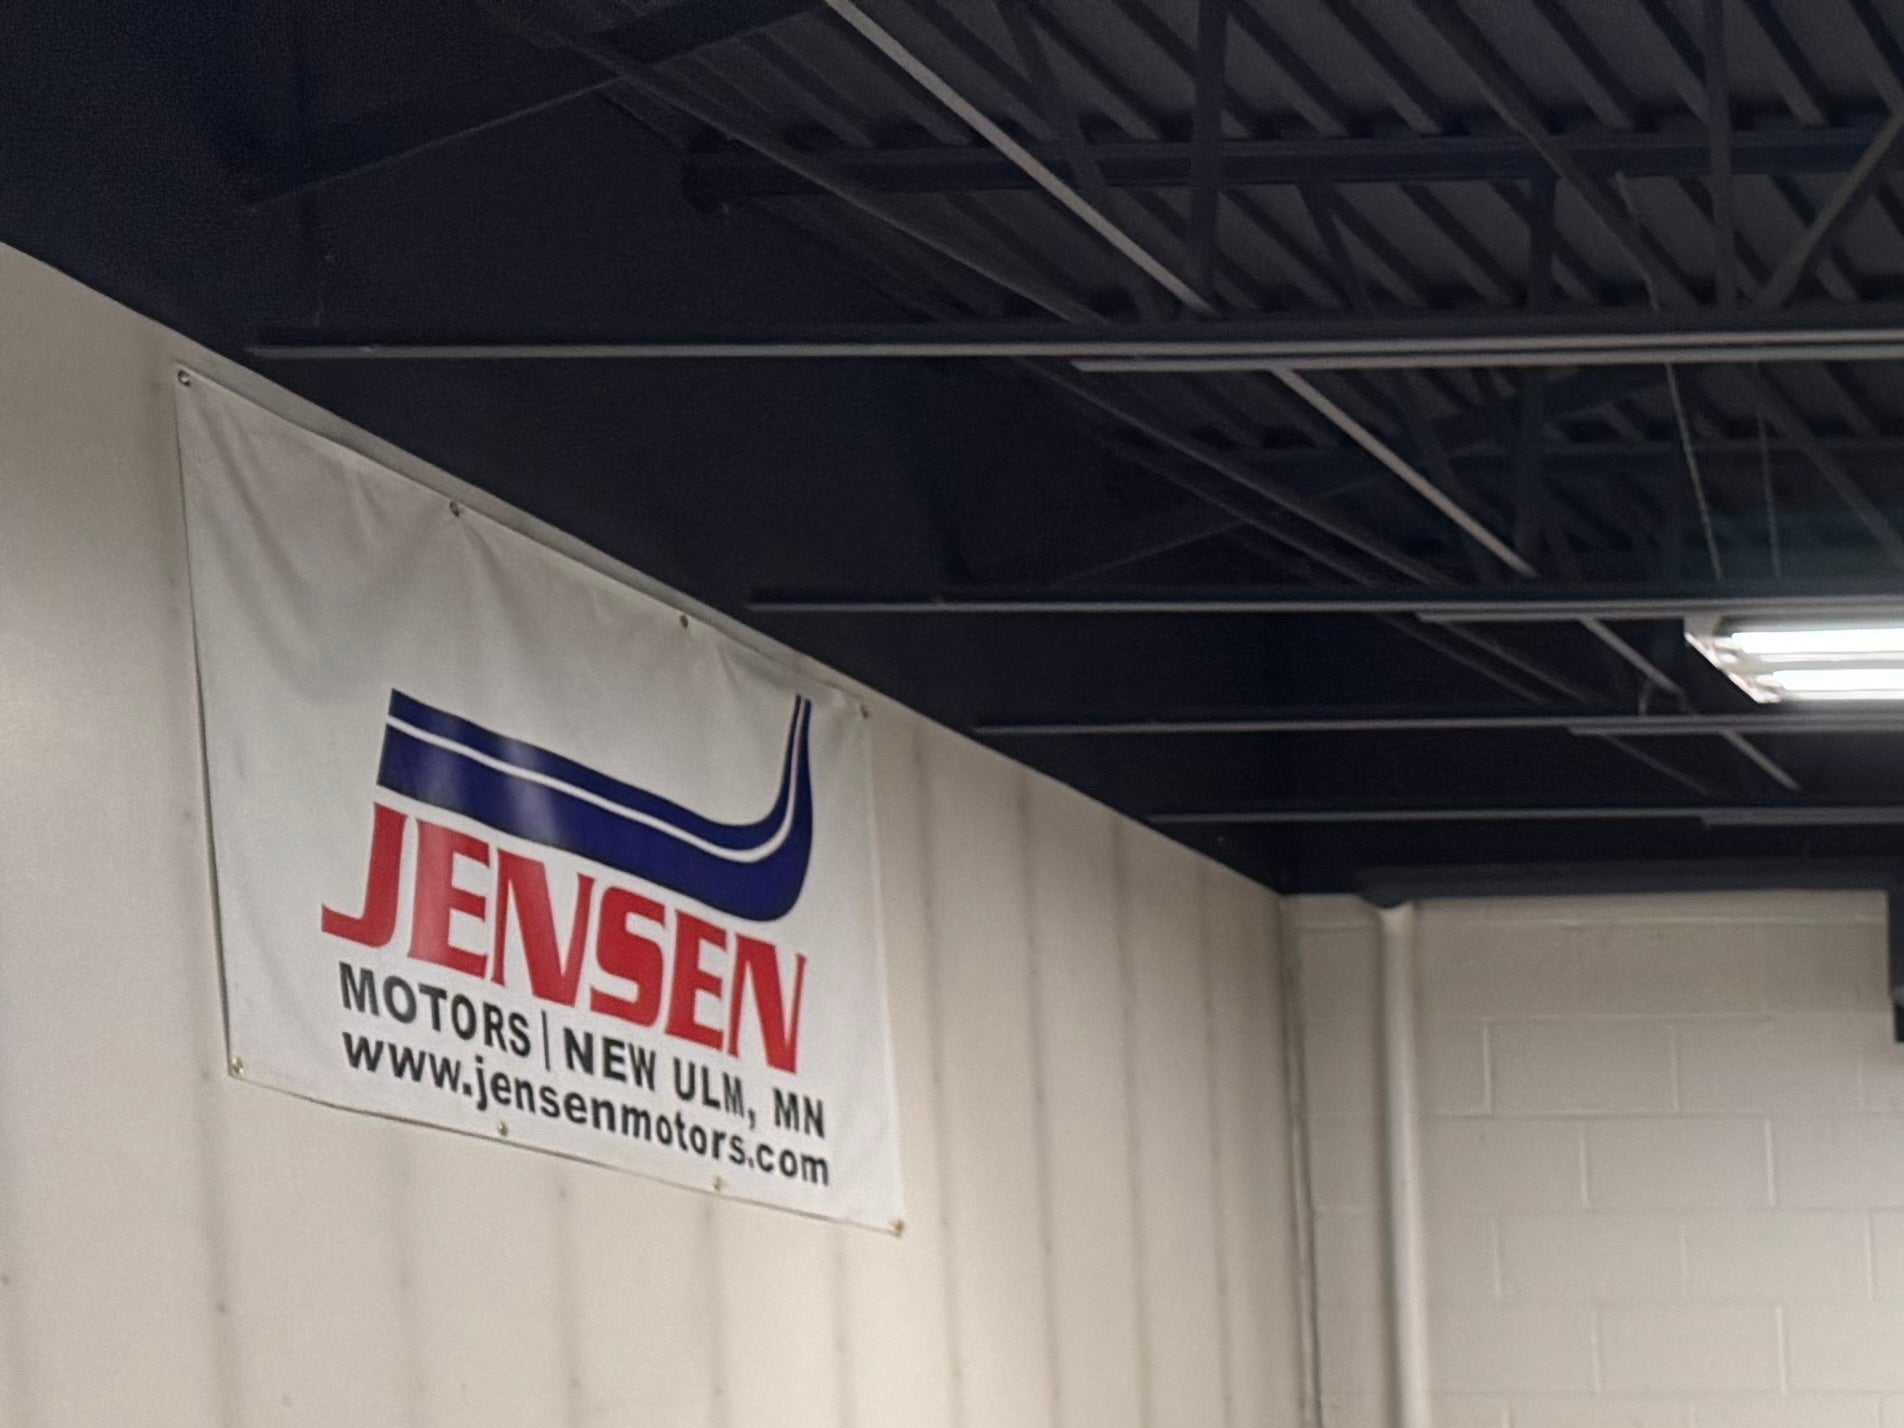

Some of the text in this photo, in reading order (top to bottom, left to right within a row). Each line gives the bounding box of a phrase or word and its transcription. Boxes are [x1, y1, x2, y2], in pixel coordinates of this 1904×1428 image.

[321, 801, 808, 1074] JENSEN
[338, 961, 532, 1059] MOTORS
[563, 1026, 657, 1092] NEW
[673, 1056, 756, 1123] ULM,
[774, 1088, 825, 1138] MN
[341, 1031, 830, 1185] www.jensenmotors.com
